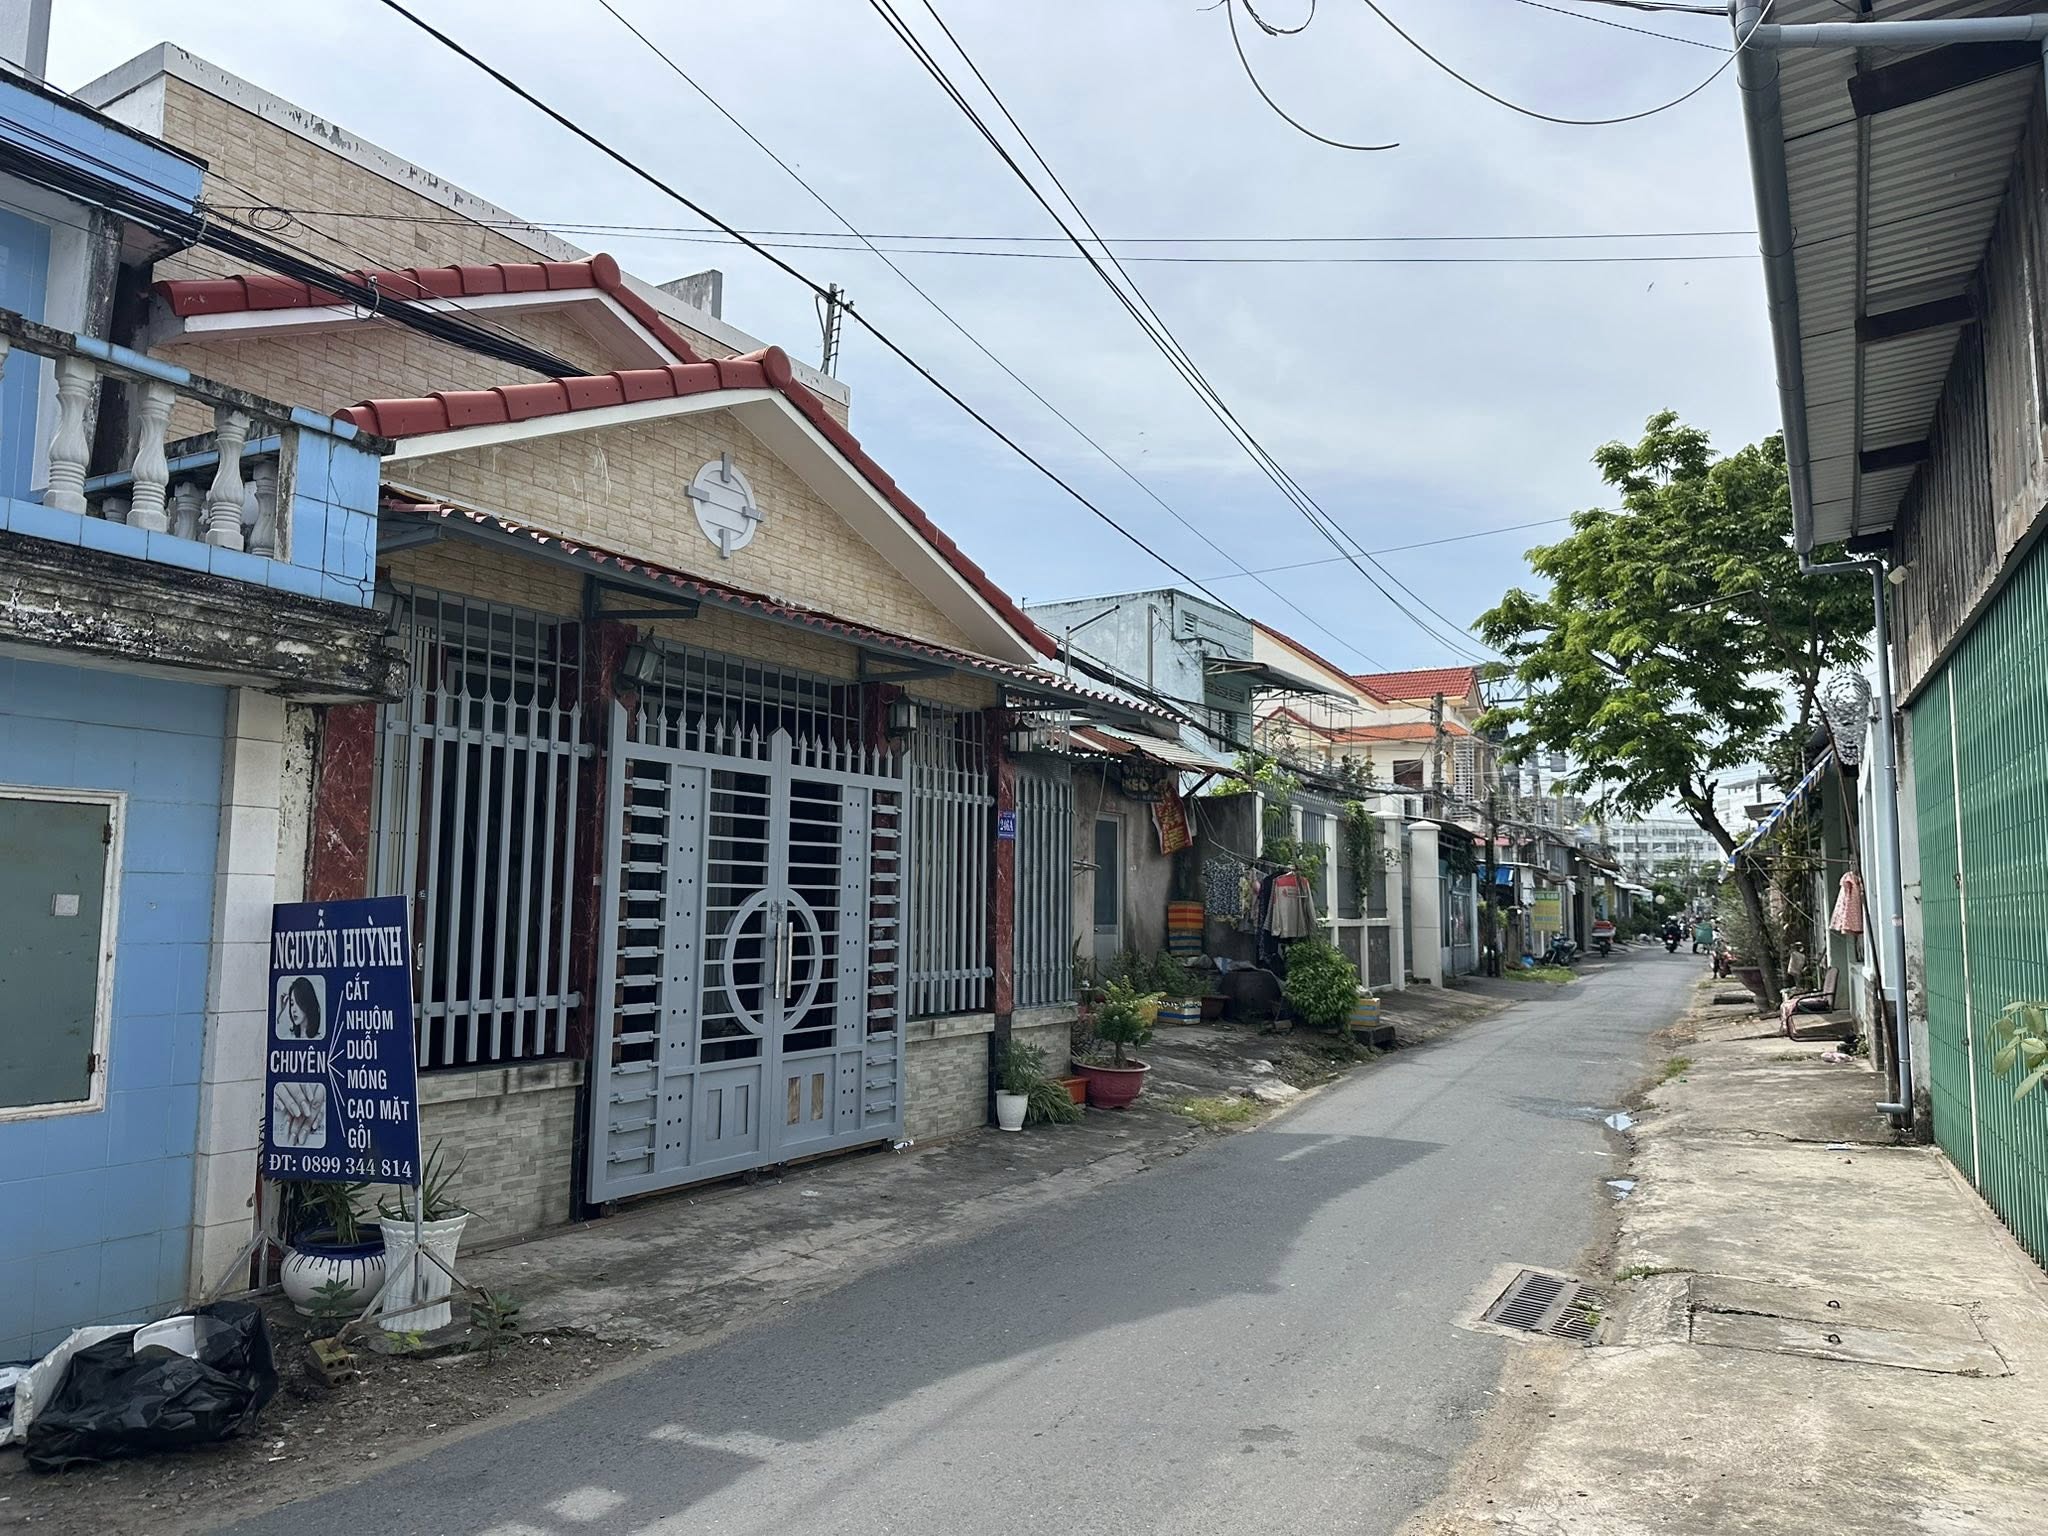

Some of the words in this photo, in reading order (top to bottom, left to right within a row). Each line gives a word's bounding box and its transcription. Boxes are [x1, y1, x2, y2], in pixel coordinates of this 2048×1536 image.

[342, 914, 403, 968] HUỲNH
[345, 972, 370, 1001] CẮT
[346, 1005, 394, 1034] NHUỘM
[270, 1045, 326, 1074] CHUYÊN
[346, 1030, 378, 1060] DUỖI
[347, 1064, 388, 1090] MÓNG
[379, 1095, 410, 1125] MẶT
[347, 1123, 371, 1153] GỘI
[269, 1153, 297, 1172] ĐT:
[302, 1155, 341, 1174] 0899
[345, 1157, 376, 1176] 344
[381, 1159, 412, 1178] 814
